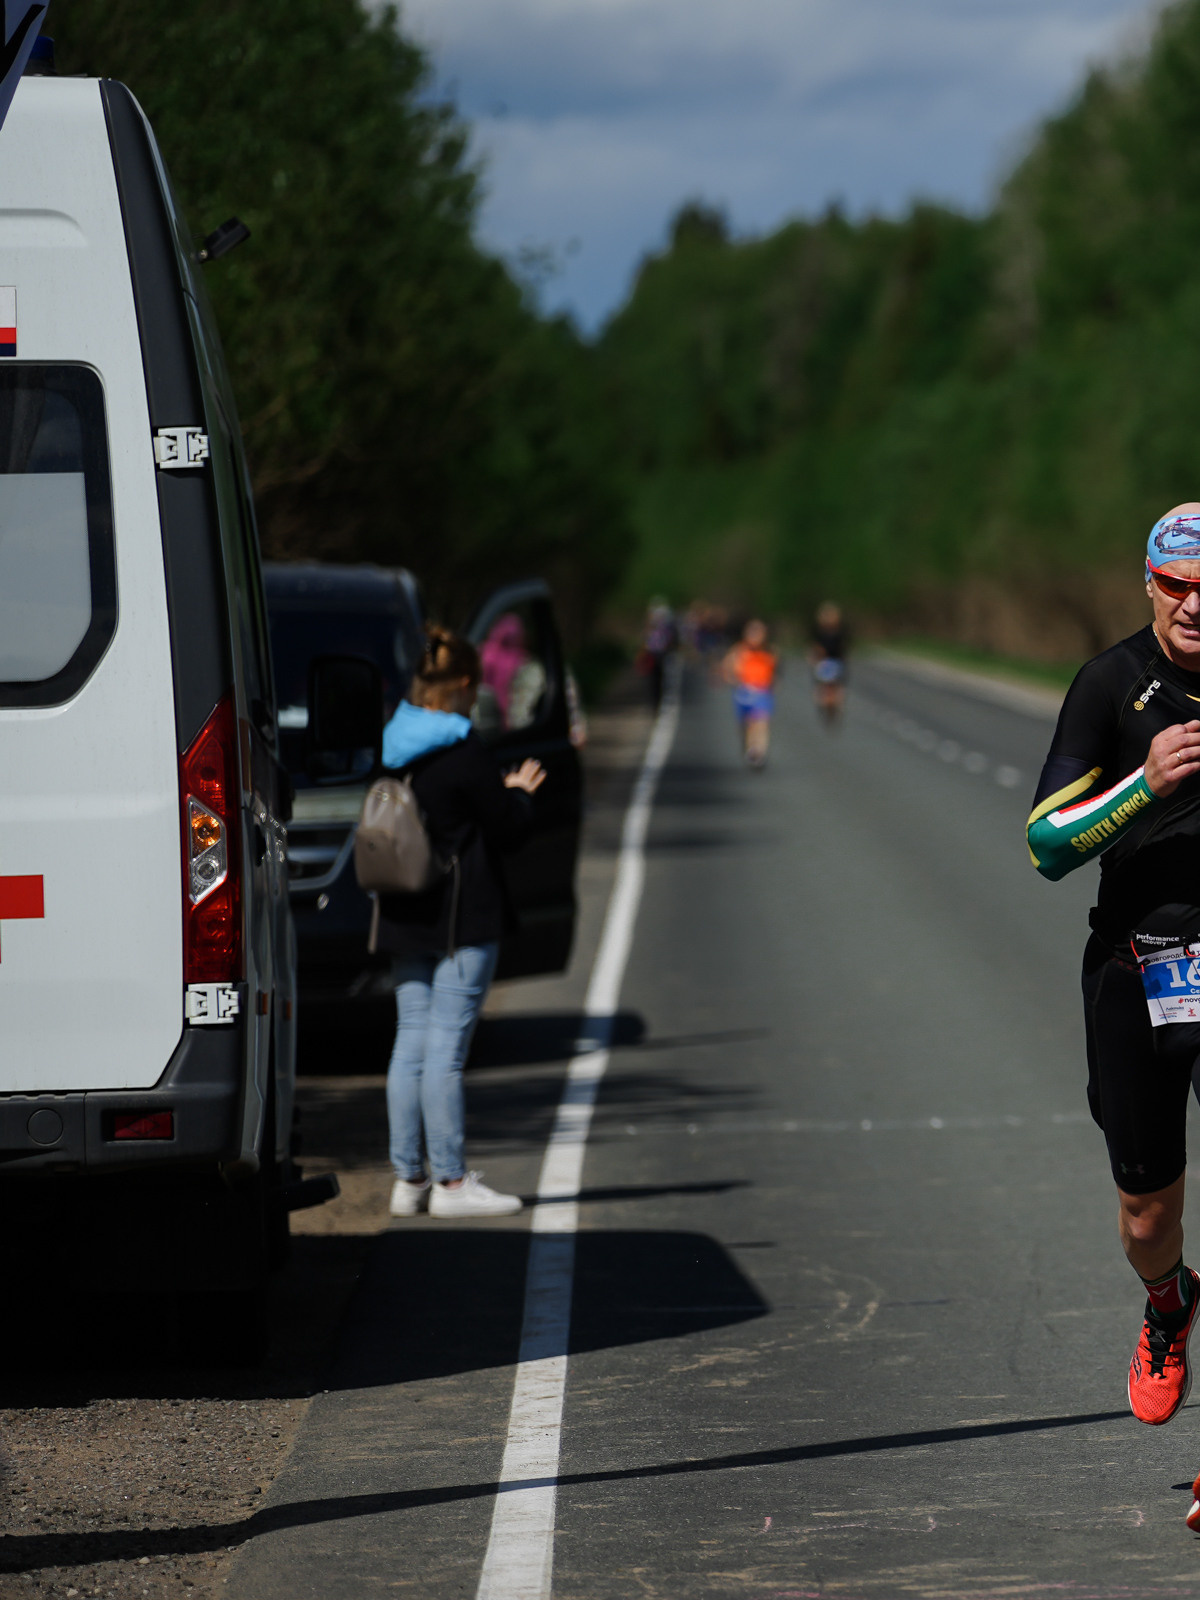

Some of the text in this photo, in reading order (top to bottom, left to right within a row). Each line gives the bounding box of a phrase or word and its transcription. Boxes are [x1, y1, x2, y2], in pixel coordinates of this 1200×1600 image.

[1070, 788, 1152, 853] SOUTH AFRICA
[1136, 933, 1179, 942] performance
